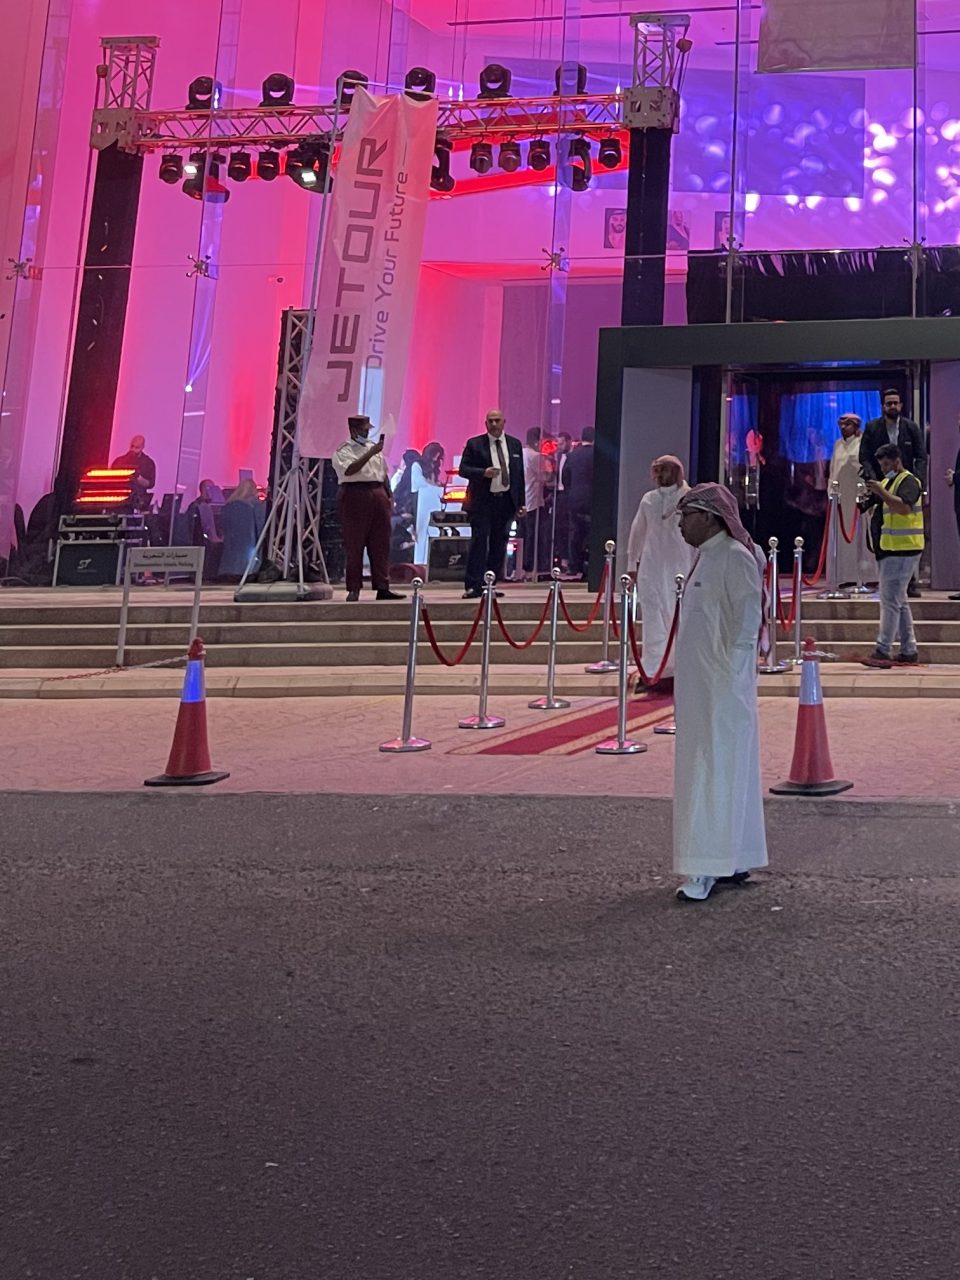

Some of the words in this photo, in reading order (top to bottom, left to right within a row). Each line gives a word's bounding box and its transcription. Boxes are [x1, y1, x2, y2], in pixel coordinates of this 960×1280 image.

[384, 171, 408, 242] Future
[327, 137, 388, 402] JETOUR
[374, 248, 397, 302] Your
[365, 310, 389, 369] Drive
